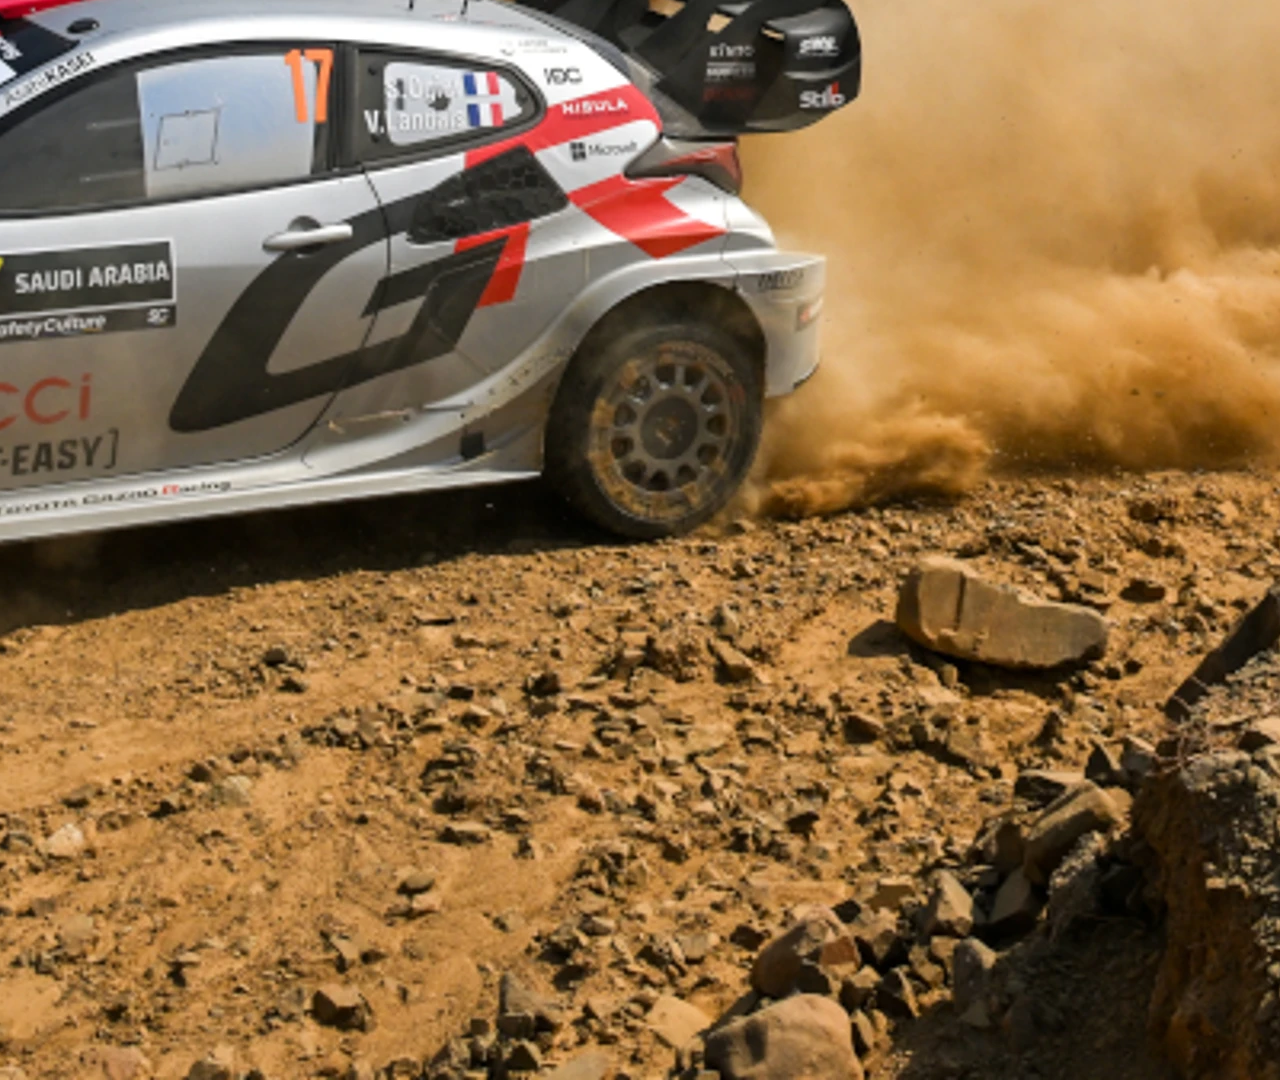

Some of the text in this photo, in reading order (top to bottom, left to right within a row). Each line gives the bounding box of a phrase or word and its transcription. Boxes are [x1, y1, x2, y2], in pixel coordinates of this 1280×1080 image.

[284, 48, 334, 124] 17
[15, 260, 171, 295] SAUDI ARABIA
